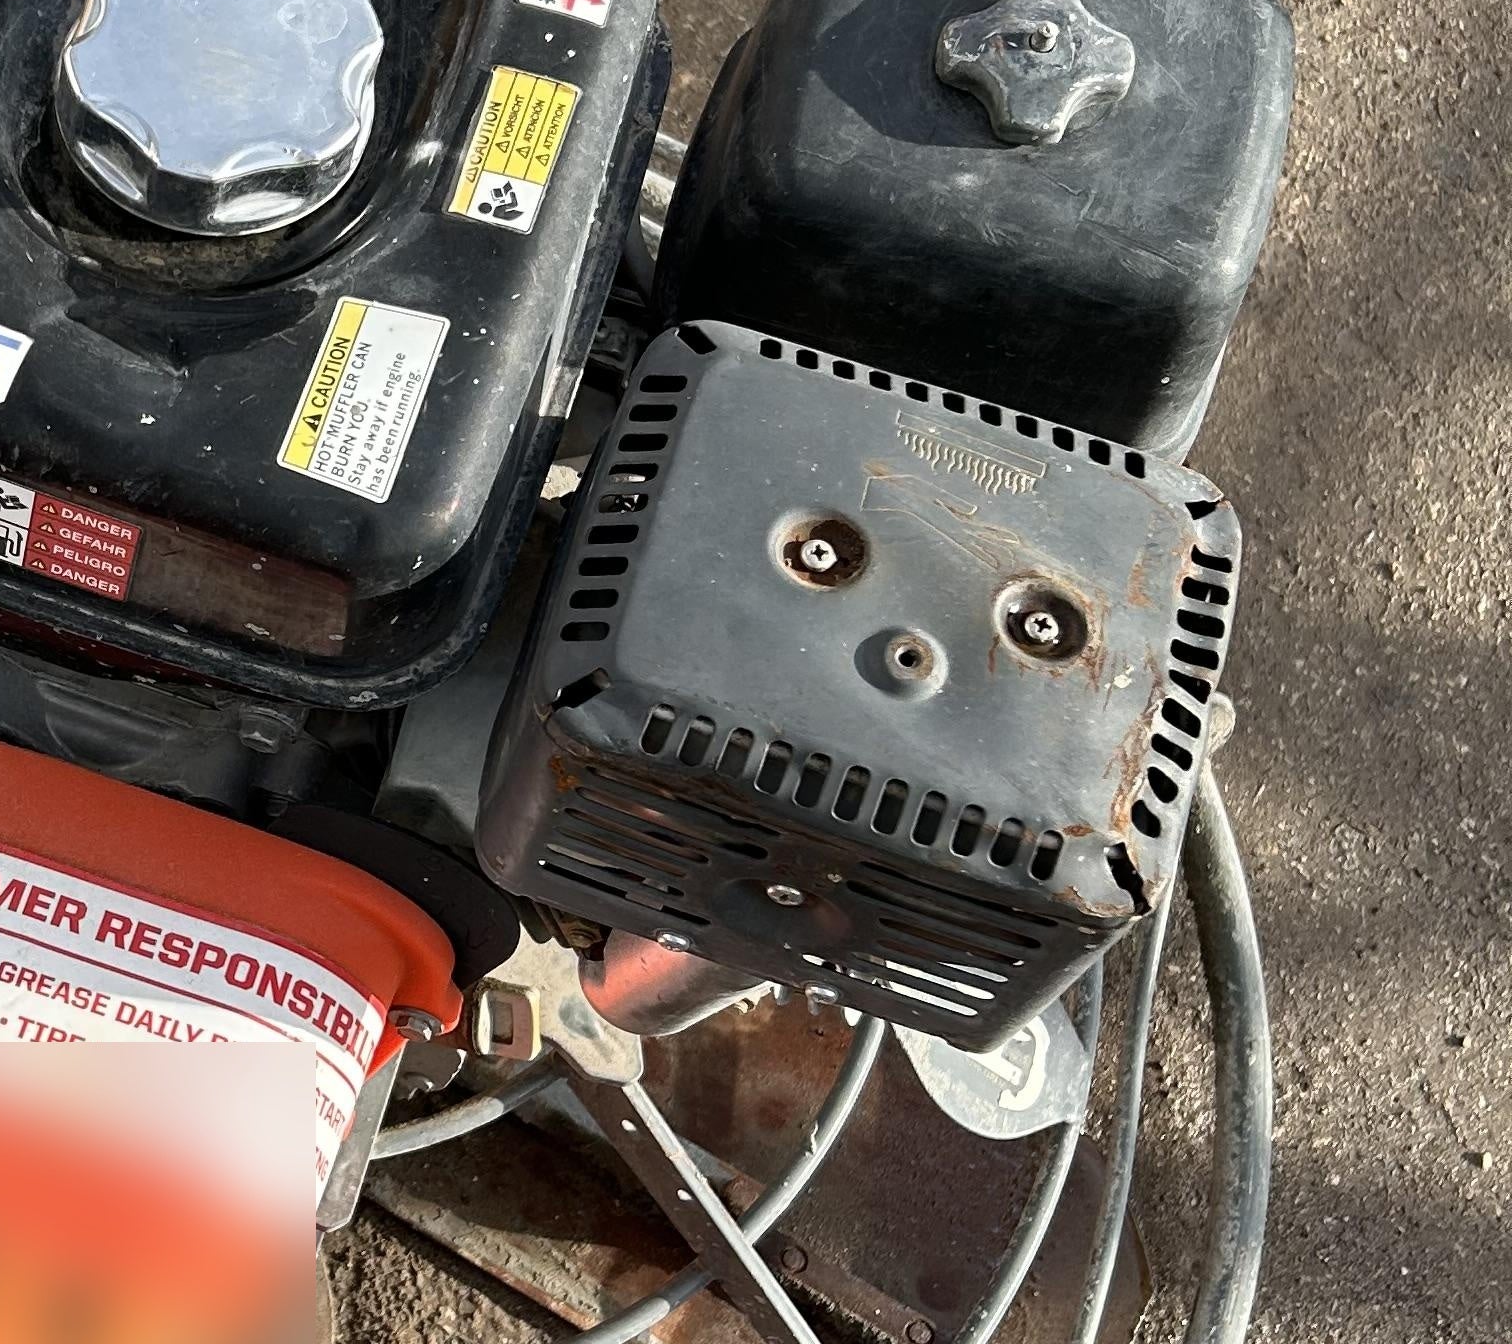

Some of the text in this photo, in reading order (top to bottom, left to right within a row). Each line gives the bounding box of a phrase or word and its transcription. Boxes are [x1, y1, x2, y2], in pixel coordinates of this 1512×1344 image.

[470, 101, 503, 166] CAUTION
[502, 94, 525, 138] VORSICHT
[543, 104, 566, 151] ATTENTION
[311, 336, 351, 408] CAUTION
[315, 342, 373, 472] HOT MUFFLER CAN
[348, 352, 406, 485] Stay away if engine
[367, 369, 422, 492] has been running.
[331, 433, 357, 477] BURN
[59, 527, 126, 559] GEFAHR
[60, 508, 133, 541] DANGER
[50, 564, 120, 596] DANGER
[52, 545, 126, 577] PELIGRO
[114, 1001, 204, 1042] DAILY
